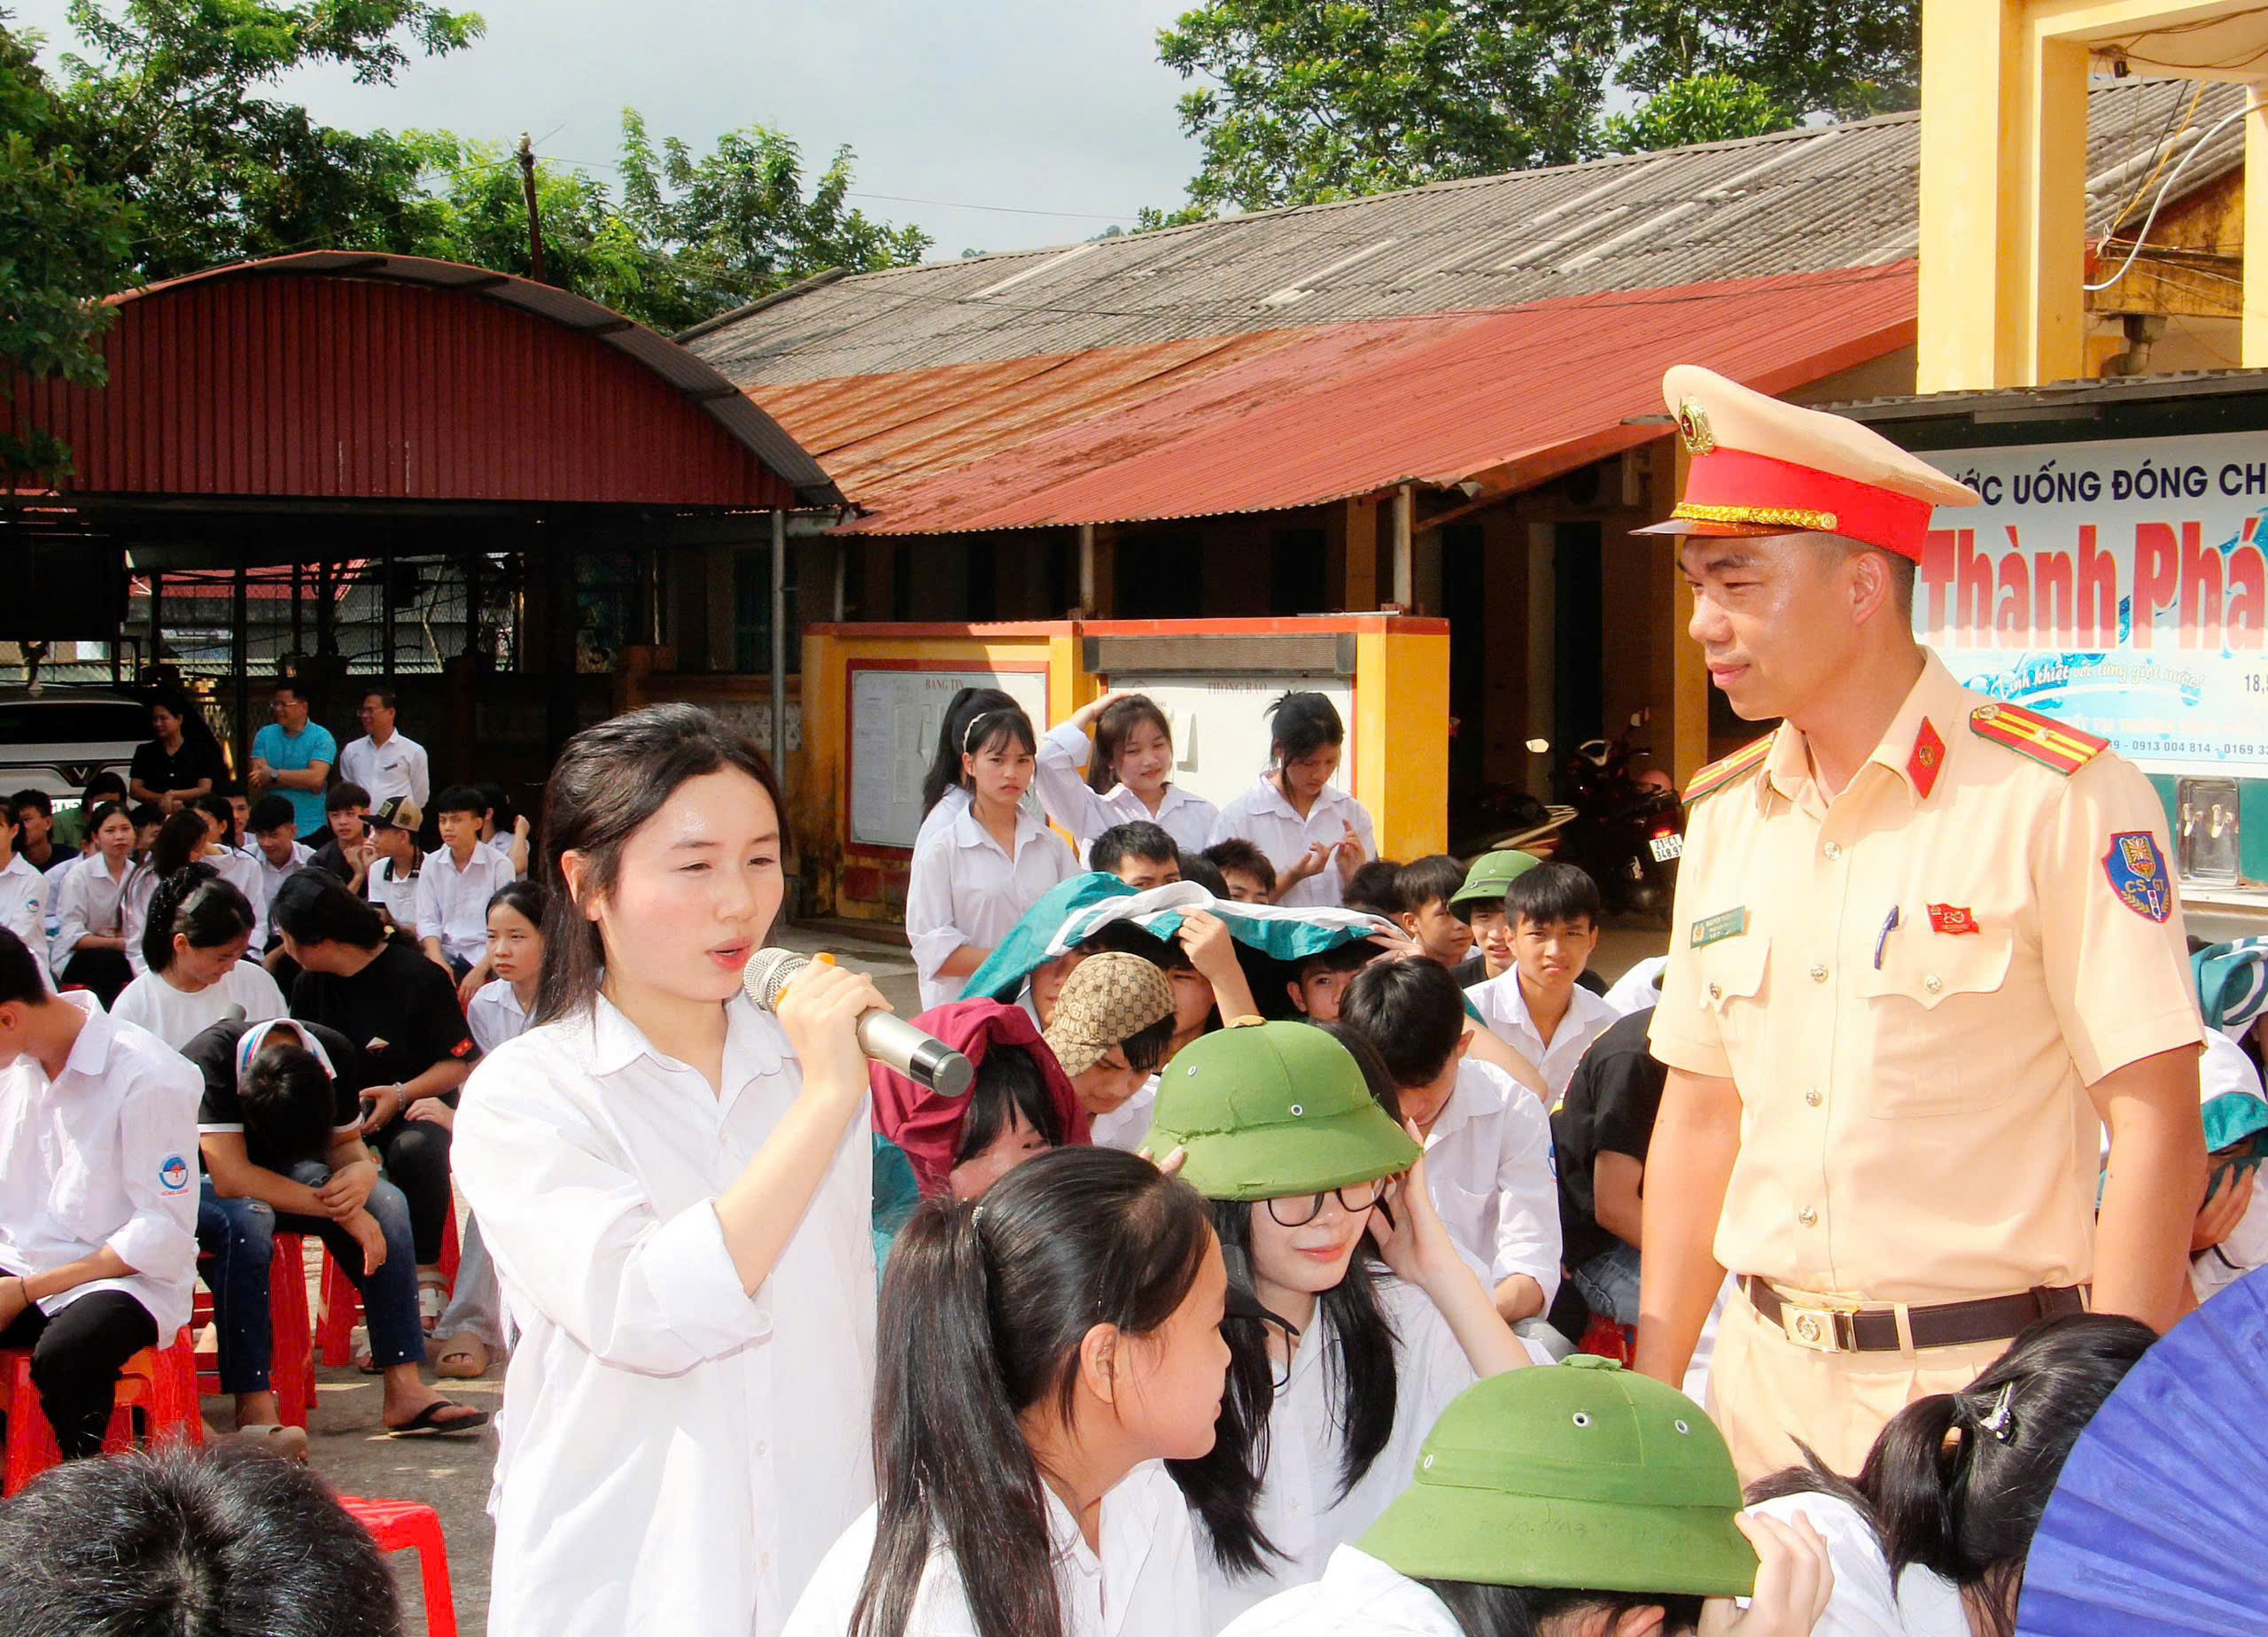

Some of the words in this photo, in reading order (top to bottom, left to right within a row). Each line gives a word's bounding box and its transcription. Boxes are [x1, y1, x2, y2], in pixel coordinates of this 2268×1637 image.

[1953, 468, 2002, 506] ỚC
[2013, 460, 2101, 504] UỐNG
[2112, 459, 2208, 500] ĐÓNG
[2218, 462, 2267, 496] CH
[1921, 524, 2118, 649] Thành
[2132, 517, 2267, 649] Phá
[2132, 740, 2160, 751] 0913
[2163, 741, 2185, 752] 004
[2189, 742, 2210, 753] 814
[2224, 743, 2254, 755] 0169
[2124, 879, 2148, 893] CS
